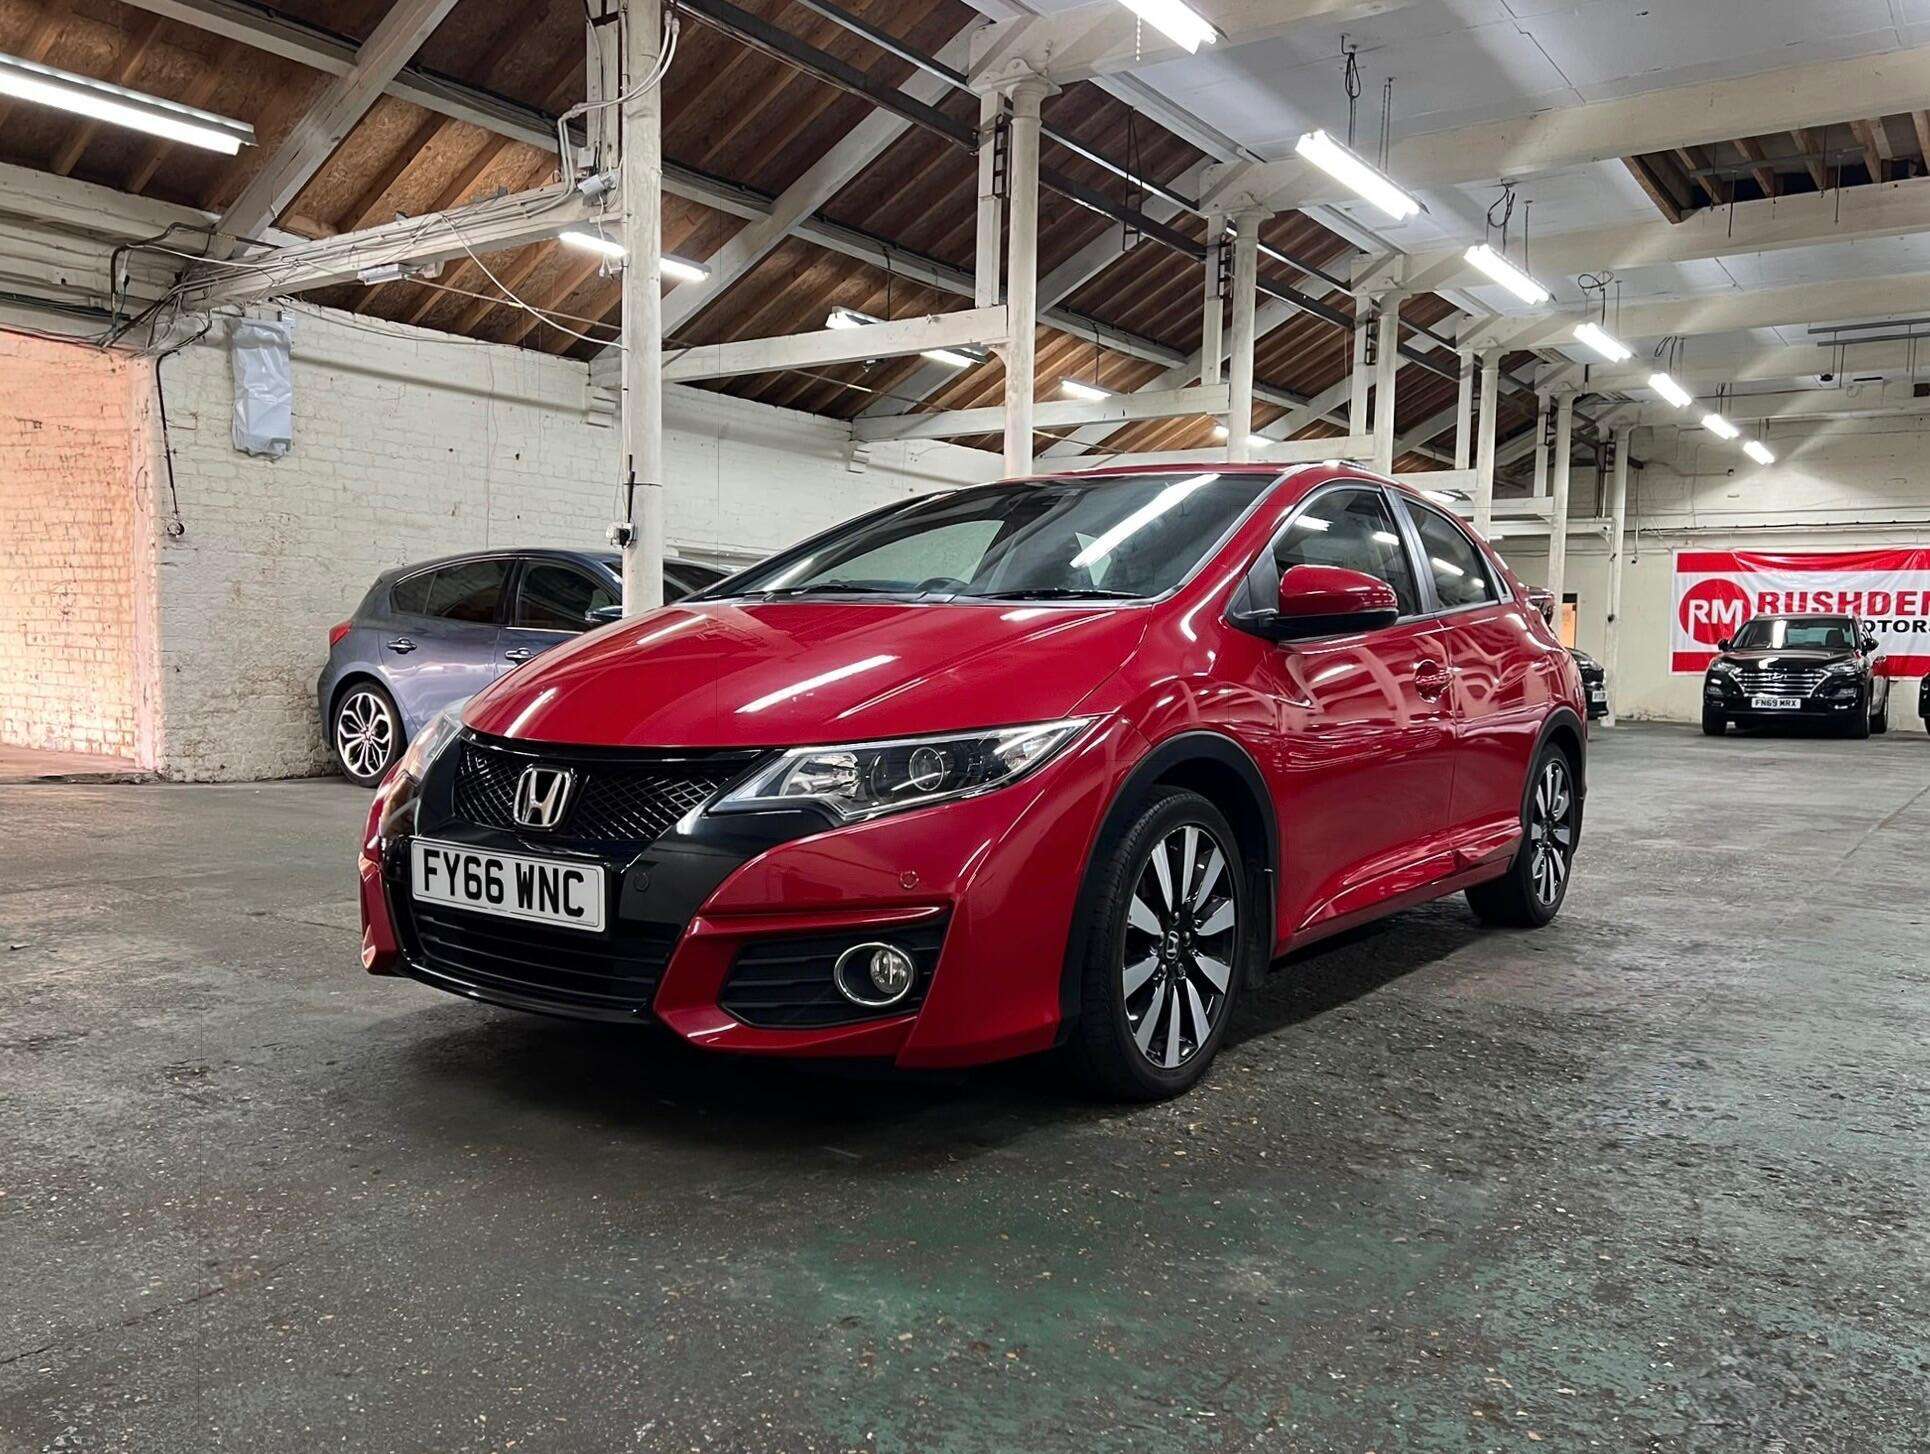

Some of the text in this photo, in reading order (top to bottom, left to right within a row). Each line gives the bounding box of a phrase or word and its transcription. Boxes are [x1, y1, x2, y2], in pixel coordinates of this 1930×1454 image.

[1688, 598, 1743, 632] RM
[1862, 619, 1930, 633] OTOR
[423, 848, 584, 917] FY66 WNC
